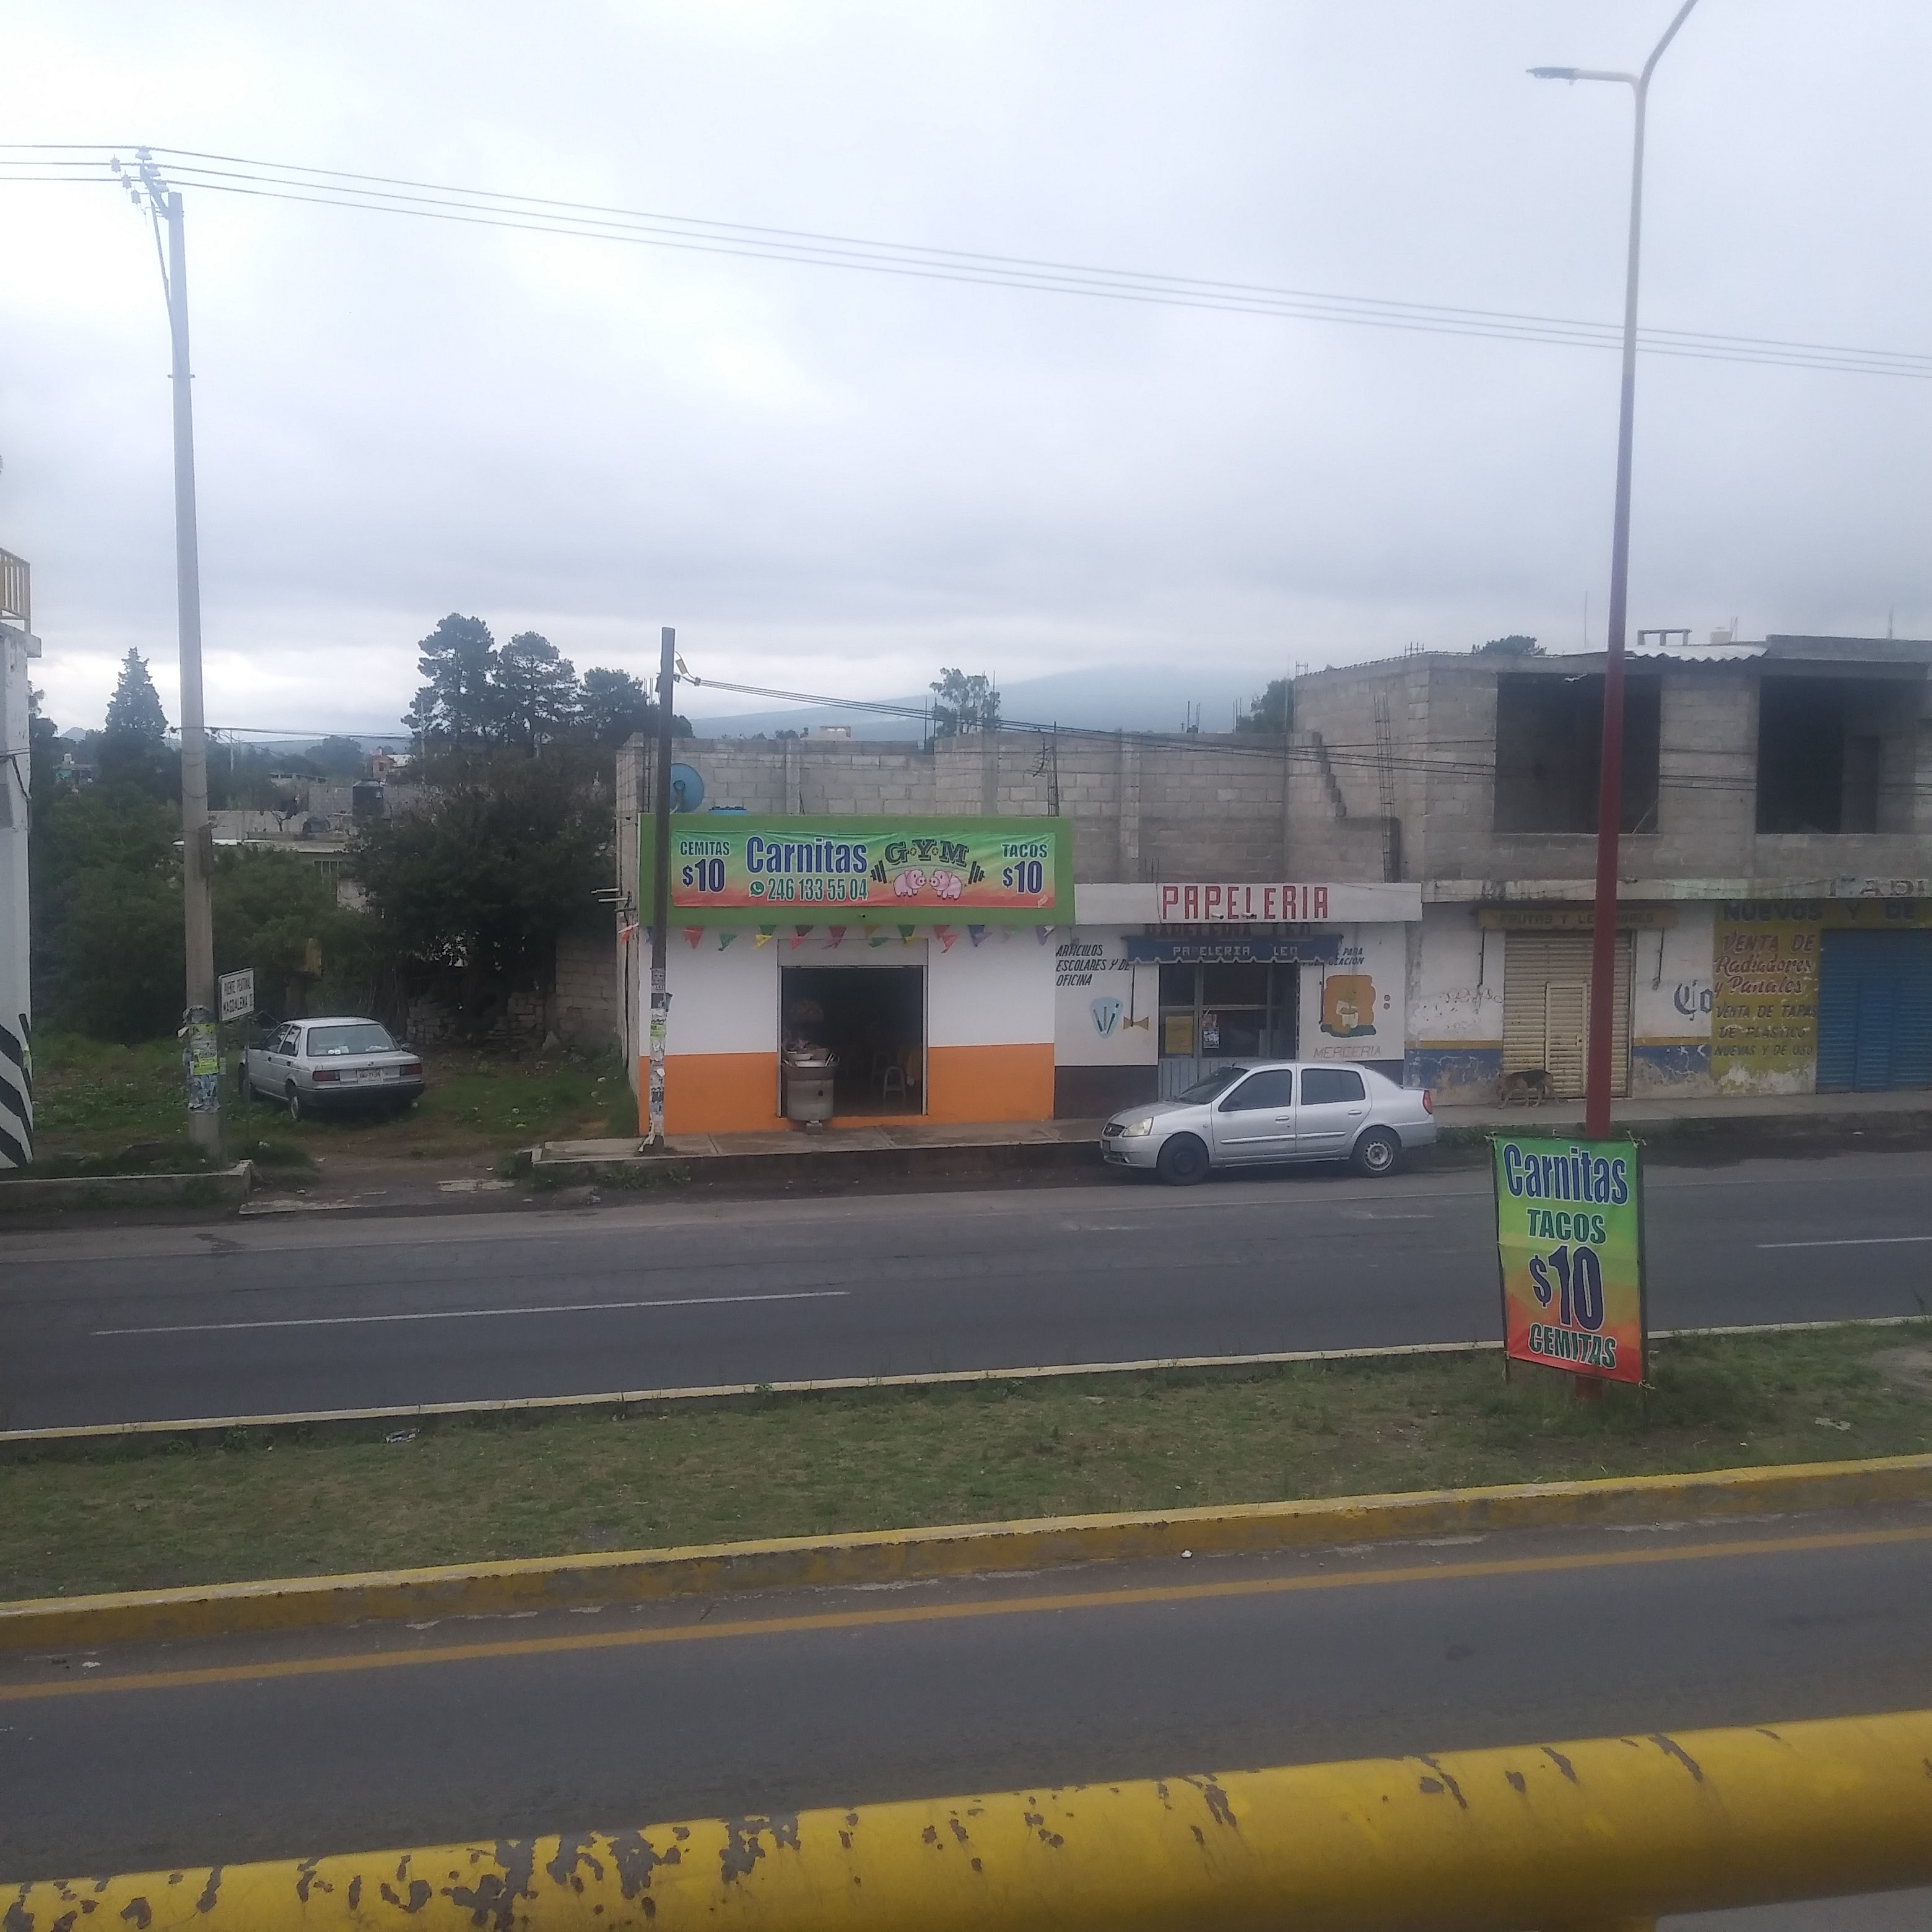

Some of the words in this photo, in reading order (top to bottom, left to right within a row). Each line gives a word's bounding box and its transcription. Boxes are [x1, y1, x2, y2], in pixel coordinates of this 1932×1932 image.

[680, 841, 729, 856] CEMITAS
[747, 837, 868, 874] Carnitas
[1001, 843, 1048, 858] TACOS
[682, 858, 725, 892] $10
[1002, 860, 1043, 894] $10
[767, 878, 794, 901] 246
[798, 878, 823, 901] 133
[827, 878, 846, 901] 55
[850, 878, 868, 901] 04
[1162, 886, 1328, 920] PAPELERIA
[1723, 930, 1779, 954] VENTA
[1791, 934, 1816, 953] DE
[1056, 959, 1107, 972] ESCOLARES
[1108, 959, 1119, 971] Y
[1714, 953, 1816, 977] Radiadores
[1056, 974, 1093, 986] OFICINA
[1716, 1001, 1749, 1019] VENTA
[1757, 1004, 1774, 1019] DE
[1313, 1045, 1381, 1058] MERCERIA
[1503, 1142, 1629, 1206] Carnitas
[1526, 1208, 1607, 1245] TACOS
[1528, 1245, 1605, 1332] $10
[1528, 1322, 1617, 1370] CEMITAS
